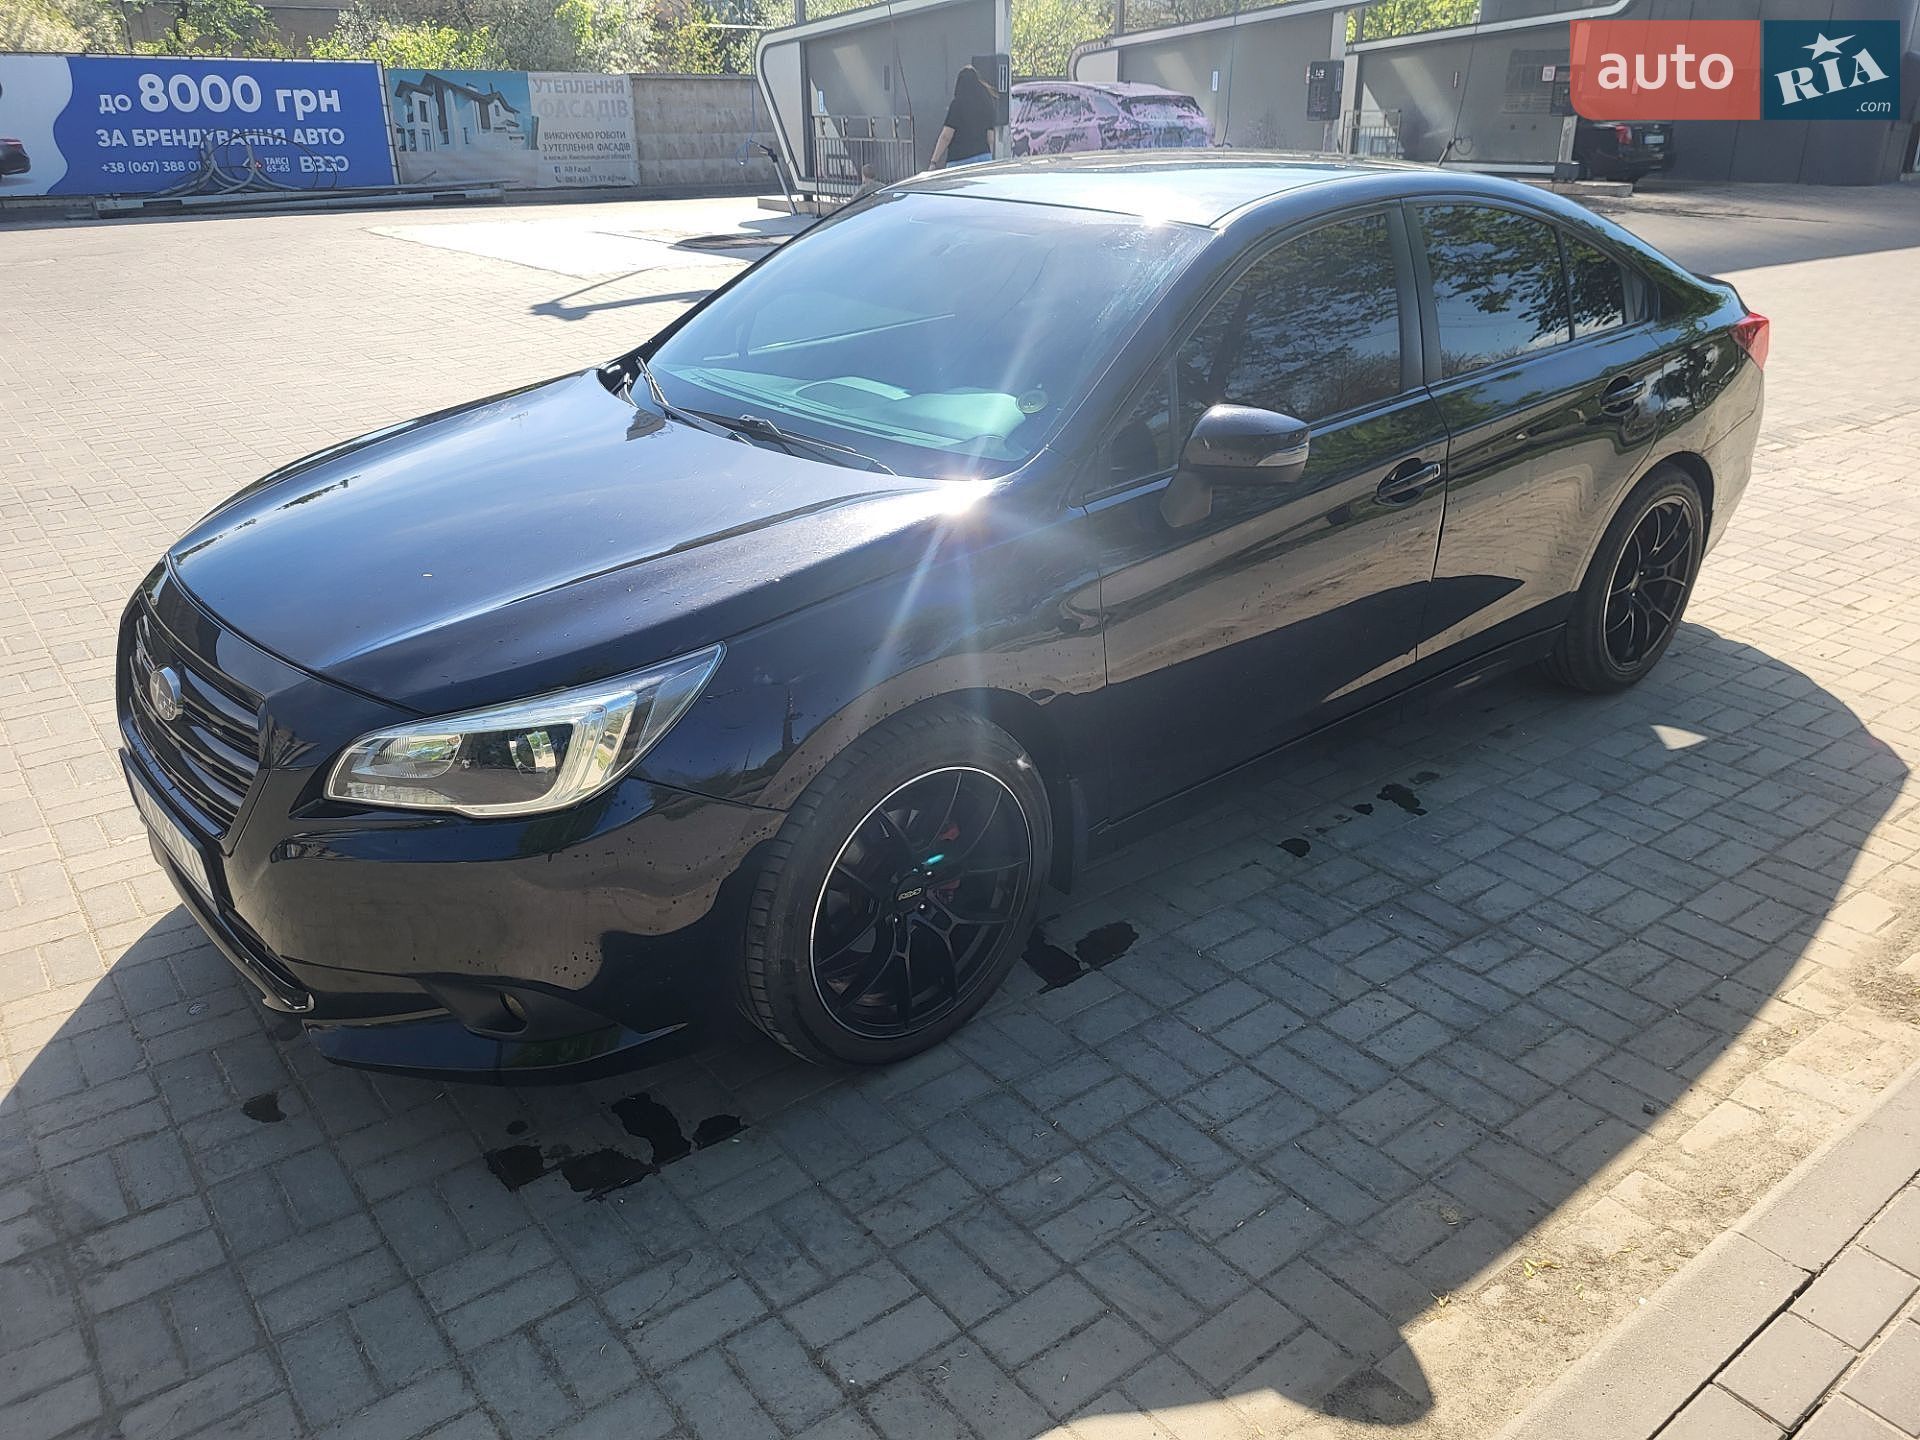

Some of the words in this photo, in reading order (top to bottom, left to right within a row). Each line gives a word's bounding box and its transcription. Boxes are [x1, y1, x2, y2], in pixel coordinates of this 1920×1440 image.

[99, 94, 132, 115] до
[138, 73, 262, 114] 8000
[275, 88, 341, 121] грн
[533, 79, 625, 95] УТЕПЛЕННЯ
[541, 99, 630, 122] ФАСАДІВ
[96, 128, 129, 148] ЗА
[131, 127, 288, 149] БРЕНДУВАННЯ
[293, 127, 346, 145] АВТО
[101, 161, 126, 174] +38
[128, 159, 159, 175] (067)
[161, 160, 186, 172] 388
